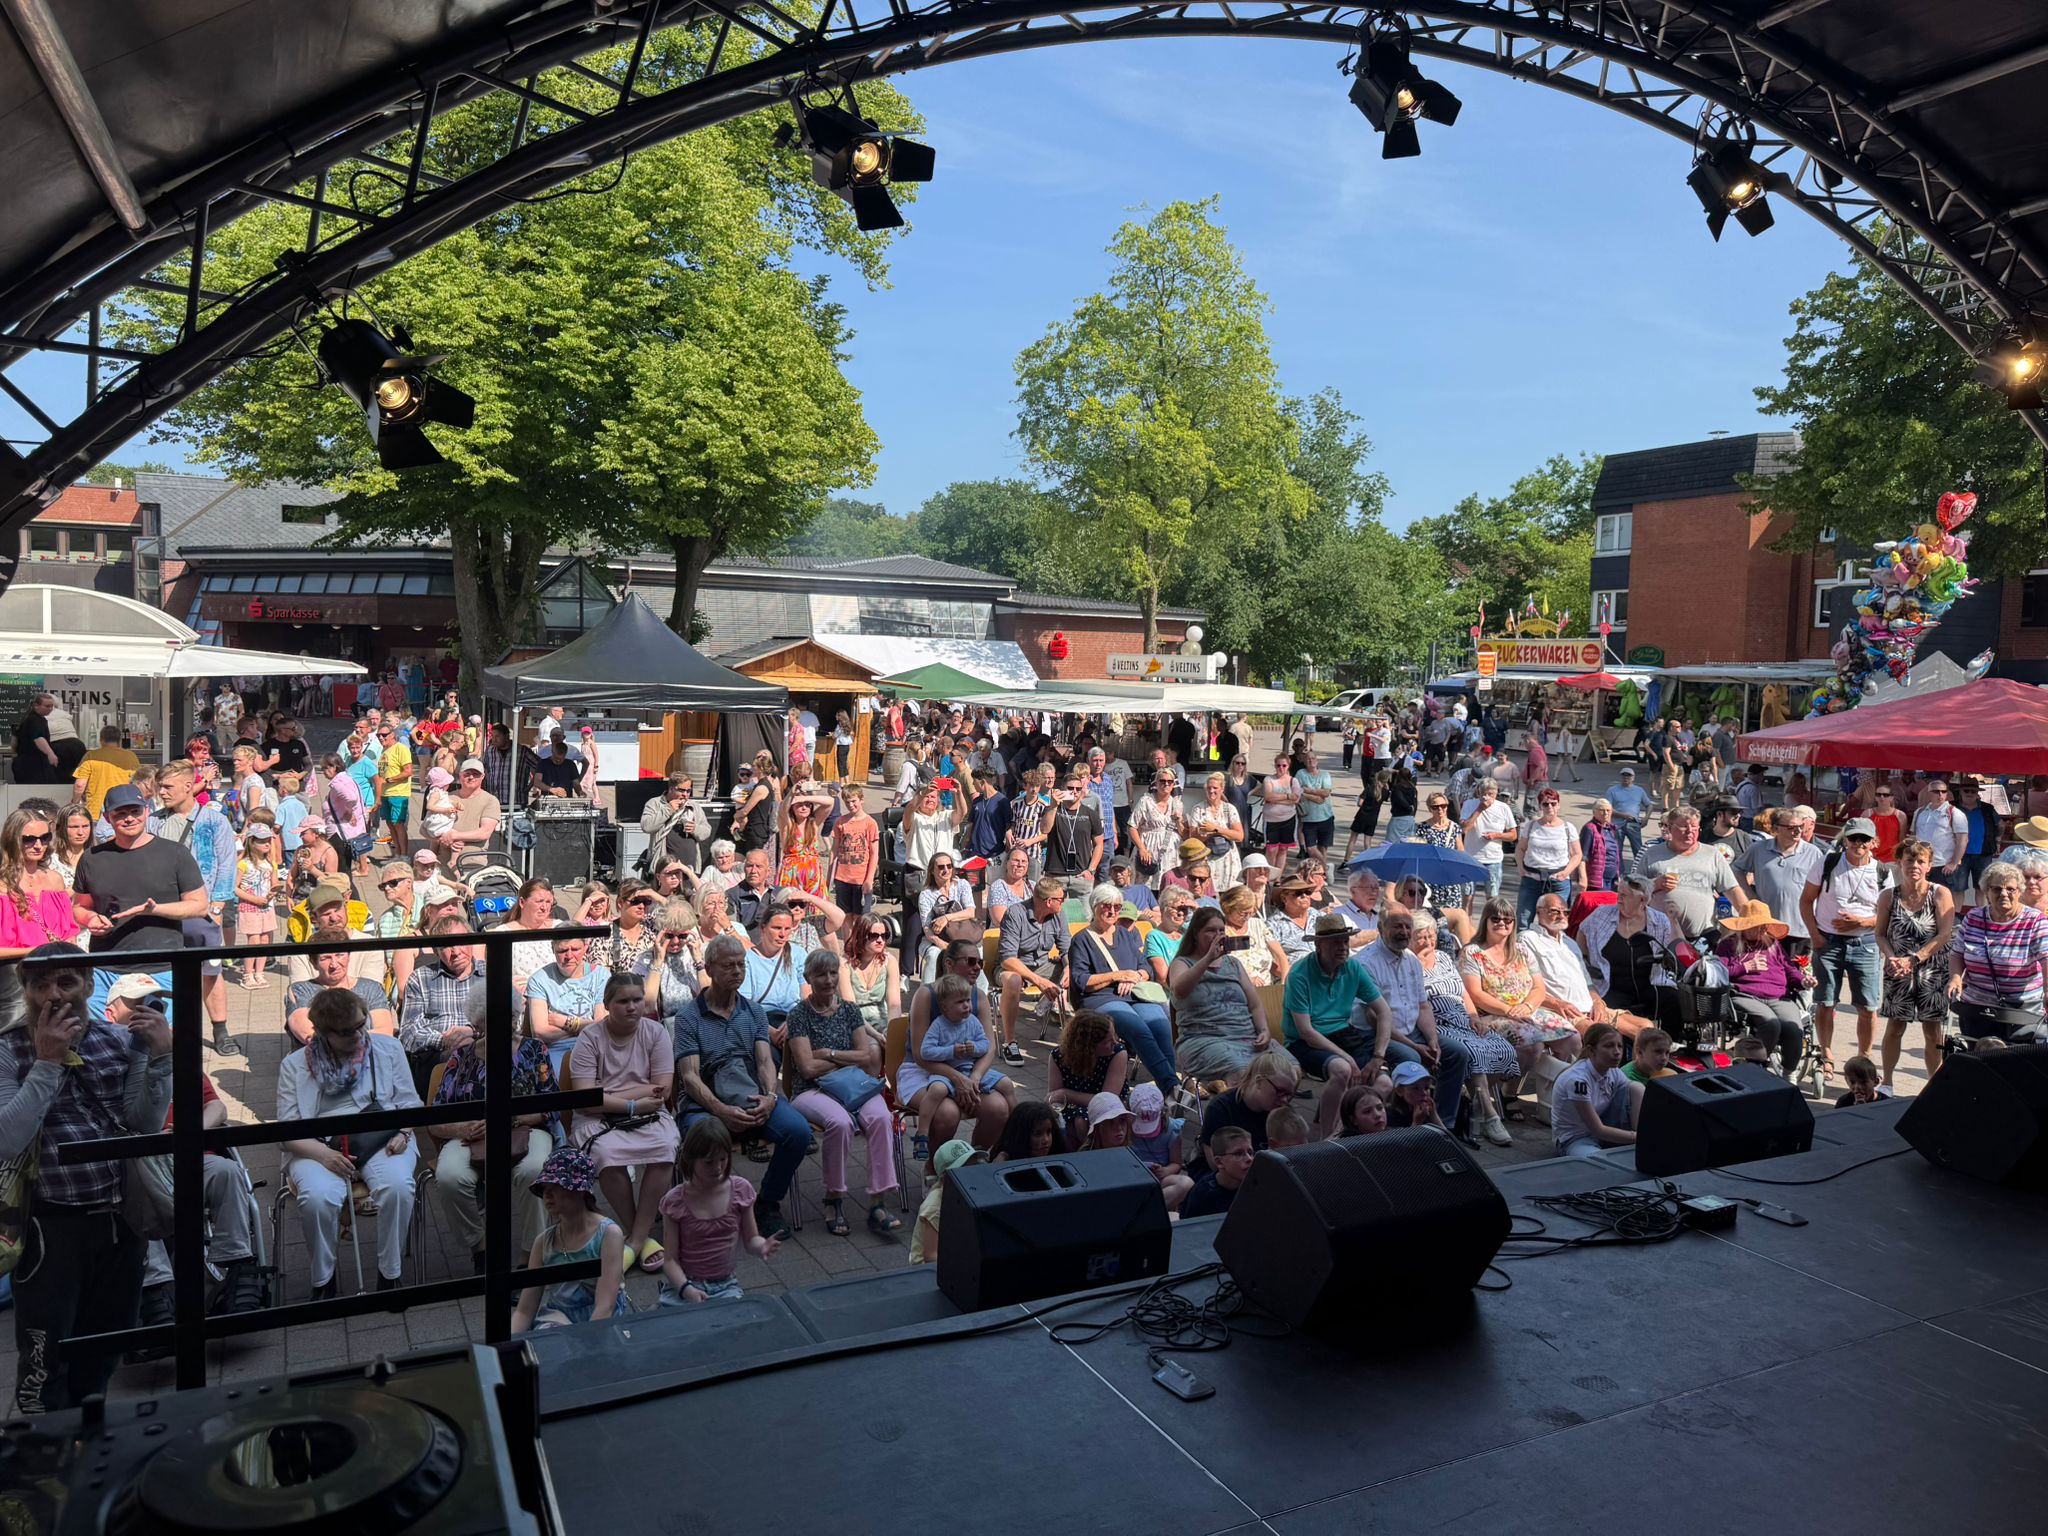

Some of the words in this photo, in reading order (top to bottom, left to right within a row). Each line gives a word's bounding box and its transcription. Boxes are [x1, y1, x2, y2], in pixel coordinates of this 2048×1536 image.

[267, 606, 320, 619] Sparkasse
[1496, 644, 1579, 665] ZUCKERWAREN
[1116, 660, 1139, 671] VELTINS
[1175, 662, 1201, 673] VELTINS
[44, 689, 112, 706] LTINS
[1575, 1080, 1588, 1095] 10
